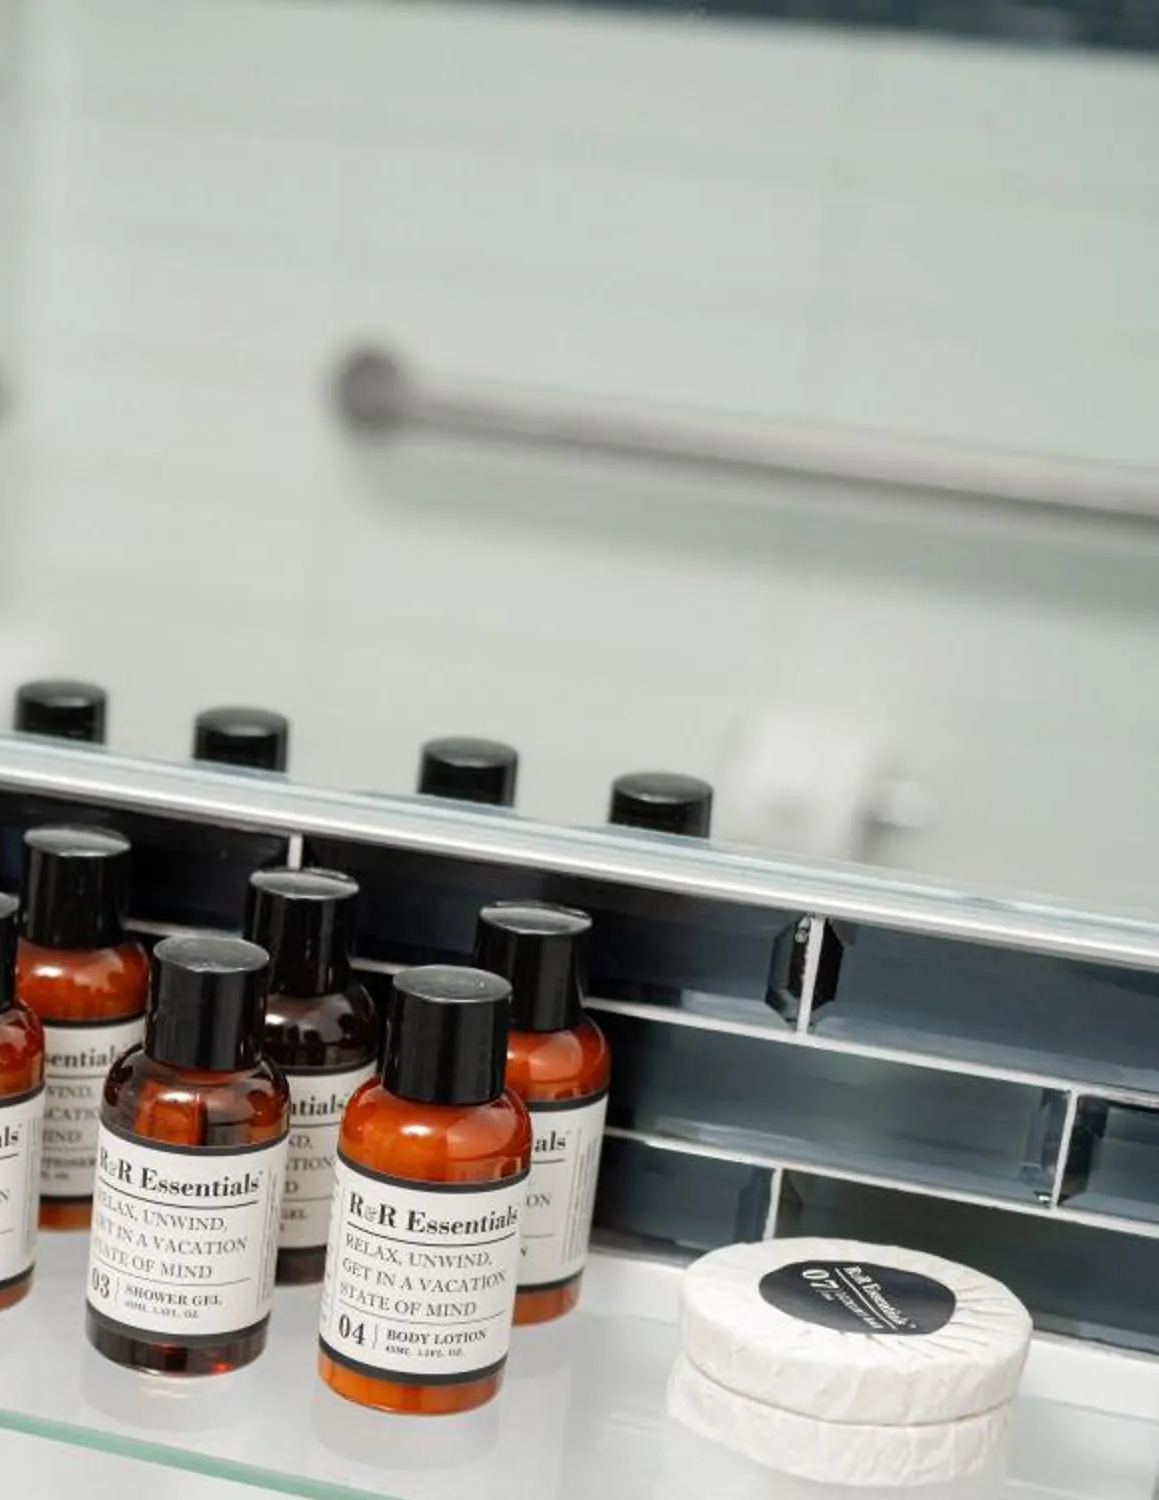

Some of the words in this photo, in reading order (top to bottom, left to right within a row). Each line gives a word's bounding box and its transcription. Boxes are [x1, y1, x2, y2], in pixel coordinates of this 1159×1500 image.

[142, 1167, 259, 1198] Essentials
[143, 1209, 228, 1232] UNWIND,
[349, 1191, 397, 1228] R&R
[406, 1205, 518, 1235] Essentials
[117, 1226, 134, 1244] IN
[137, 1233, 148, 1248] A
[153, 1236, 249, 1255] VACATION
[345, 1233, 402, 1265] RELAX,
[409, 1251, 493, 1269] UNWIND,
[132, 1255, 156, 1274] OF
[160, 1263, 213, 1279] MIND
[342, 1257, 373, 1281] GET
[376, 1271, 397, 1289] IN
[400, 1275, 413, 1290] A
[420, 1270, 507, 1293] VACATION
[802, 1269, 840, 1289] 07
[92, 1267, 111, 1299] 03
[125, 1284, 188, 1305] SHOWER
[191, 1295, 224, 1306] GEL
[340, 1282, 390, 1310] STATE
[394, 1299, 421, 1316] OF
[425, 1302, 477, 1317] MIND
[338, 1314, 366, 1346] 04
[387, 1329, 430, 1345] BODY
[433, 1328, 488, 1345] LOTION
